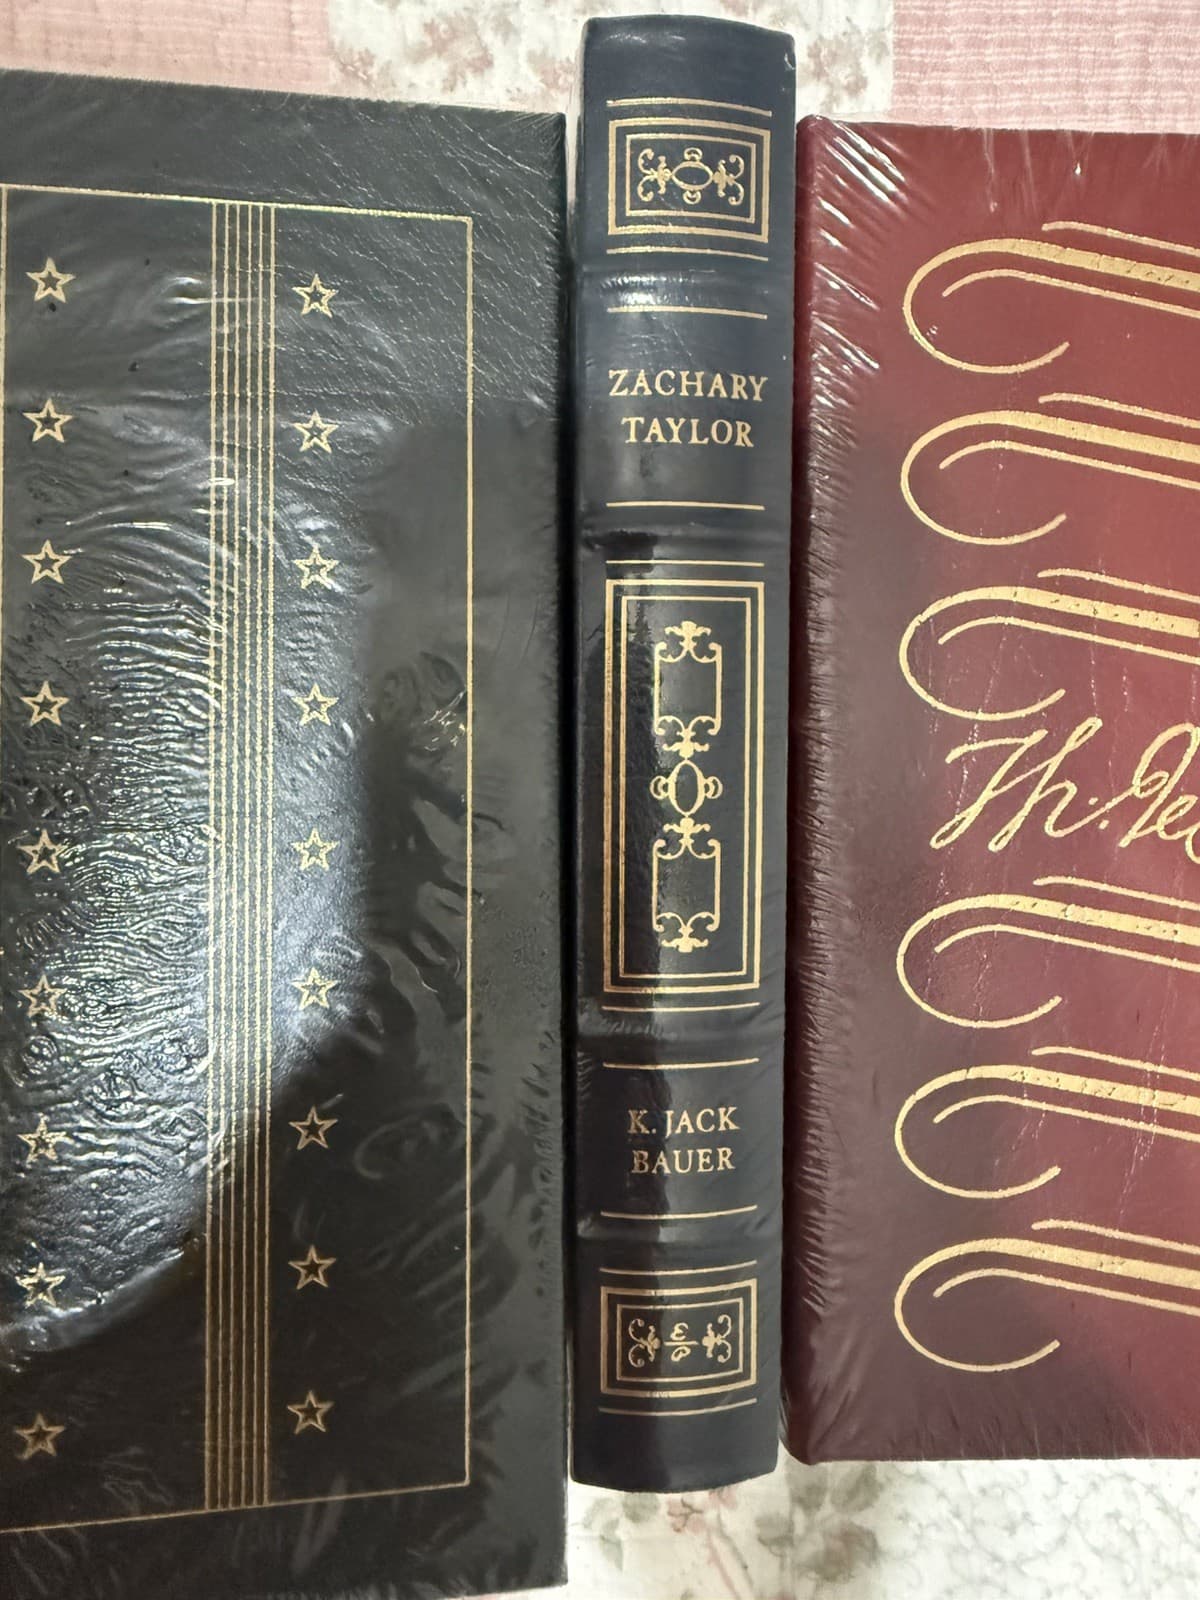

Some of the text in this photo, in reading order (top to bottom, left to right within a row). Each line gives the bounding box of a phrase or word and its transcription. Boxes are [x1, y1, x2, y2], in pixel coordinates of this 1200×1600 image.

[608, 369, 768, 401] ZACHARY
[621, 416, 754, 447] TAYLOR
[627, 1106, 740, 1138] K. JACK
[631, 1147, 736, 1174] BAUER
